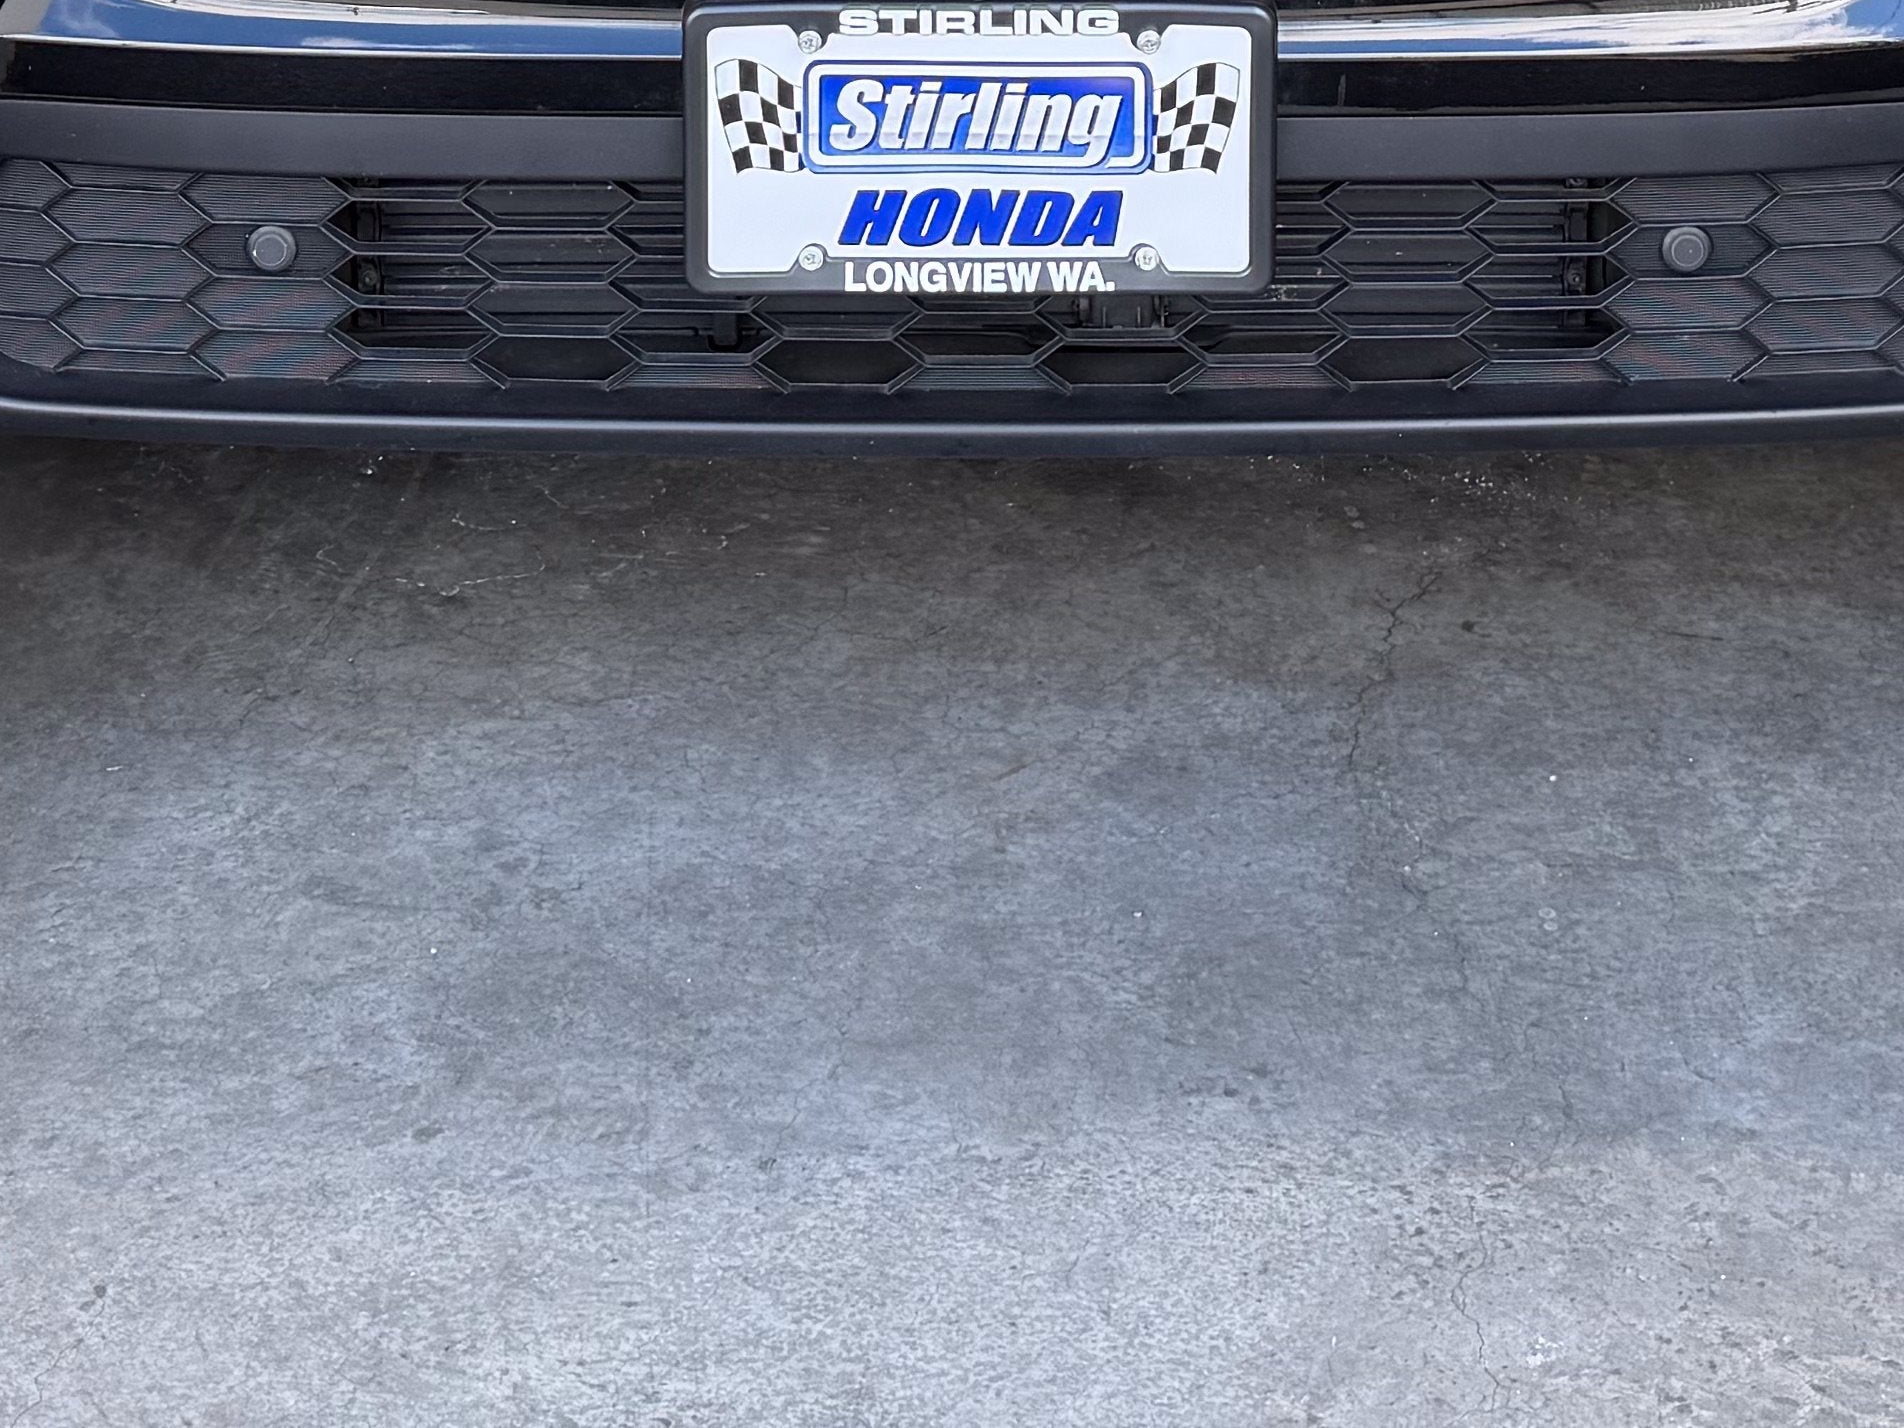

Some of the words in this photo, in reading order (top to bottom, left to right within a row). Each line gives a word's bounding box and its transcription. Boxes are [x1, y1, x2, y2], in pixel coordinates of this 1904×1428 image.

[838, 9, 1120, 36] STIRLING
[828, 78, 1123, 168] Stirling
[837, 188, 1124, 247] HONDA
[844, 262, 1042, 293] LONGVIEW
[1047, 262, 1115, 293] WA.
